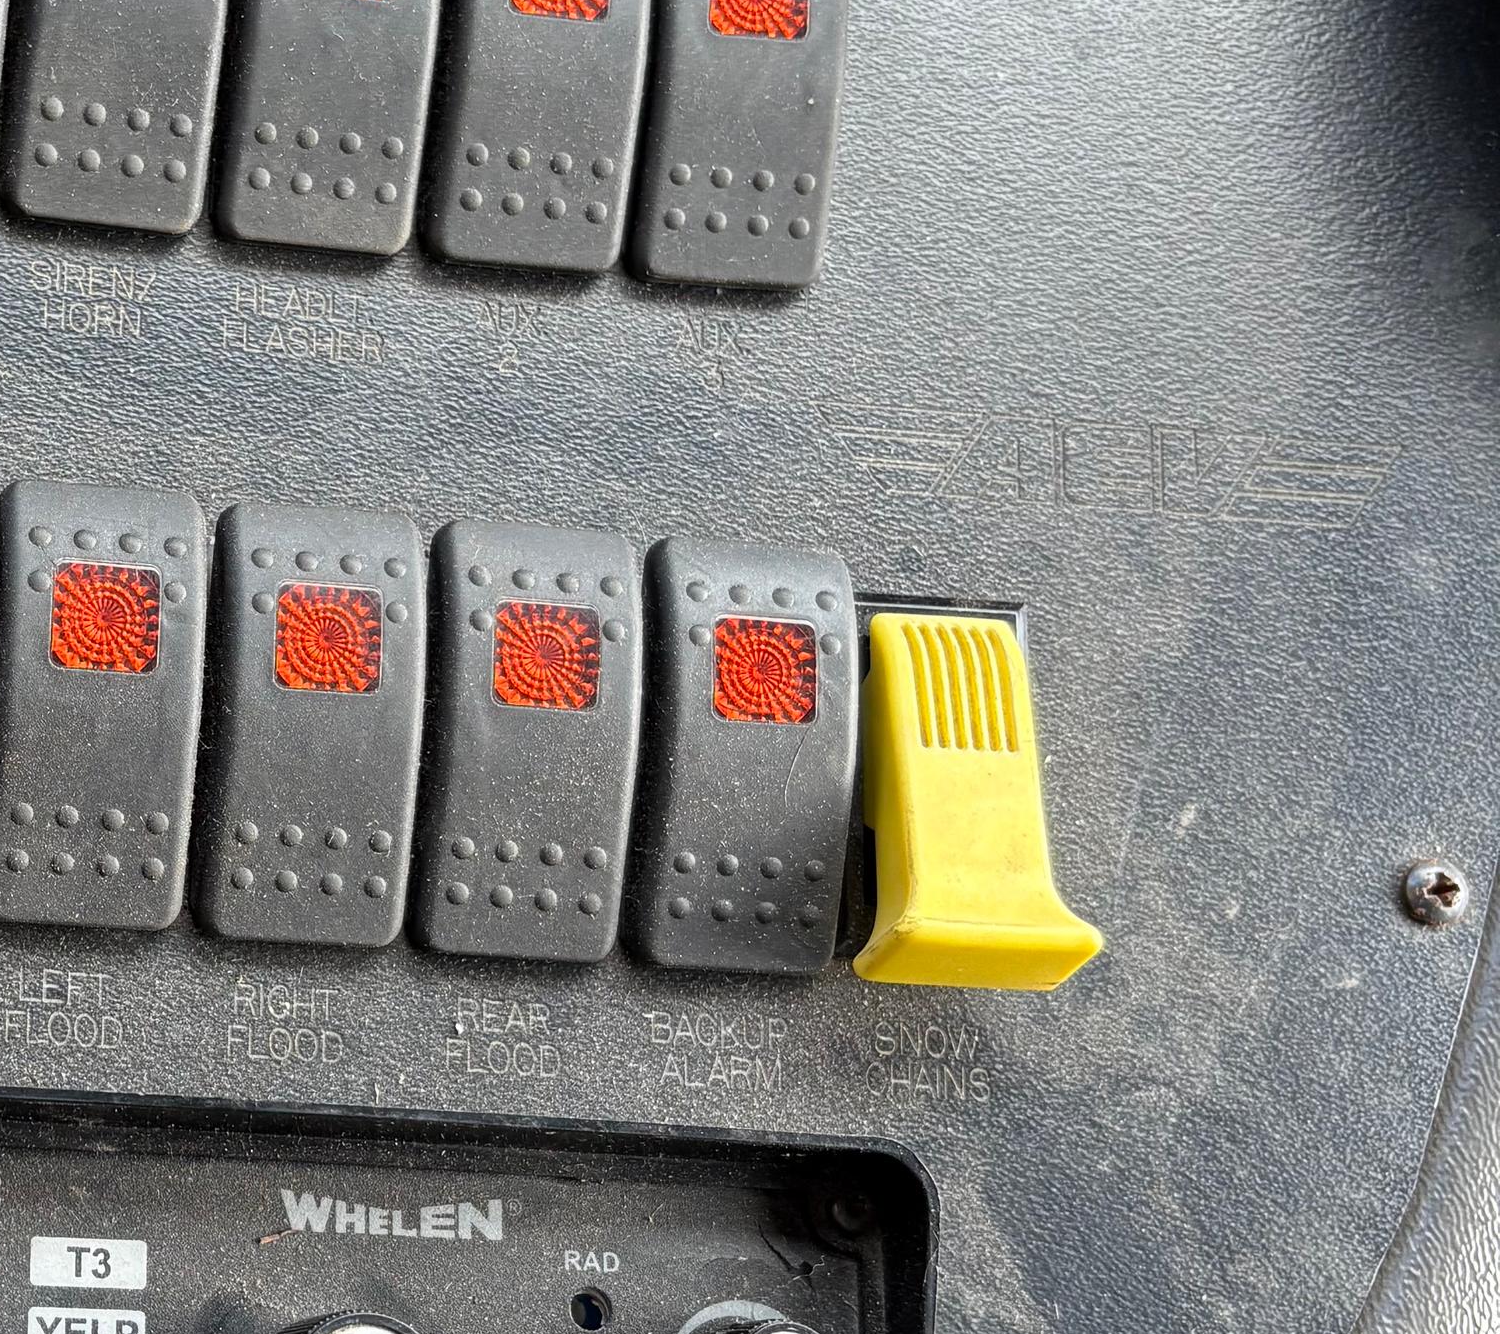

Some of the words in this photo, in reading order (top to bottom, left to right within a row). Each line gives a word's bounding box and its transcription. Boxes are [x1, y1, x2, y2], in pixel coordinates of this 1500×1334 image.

[43, 297, 142, 339] HORN
[222, 316, 386, 365] FLASHER
[17, 968, 109, 1005] LEFT
[232, 983, 339, 1019] RIGHT
[2, 1009, 125, 1051] FLOOD
[457, 997, 551, 1035] REAR
[649, 1010, 788, 1051] BACKUP
[225, 1024, 345, 1066] FLOOD
[444, 1037, 562, 1079] FLOOD
[873, 1020, 980, 1060] SNOW
[659, 1053, 783, 1092] ALARM
[865, 1061, 991, 1103] CHAINS
[281, 1188, 503, 1241] WHELEN
[65, 1246, 112, 1280] T3
[563, 1249, 620, 1274] RAD
